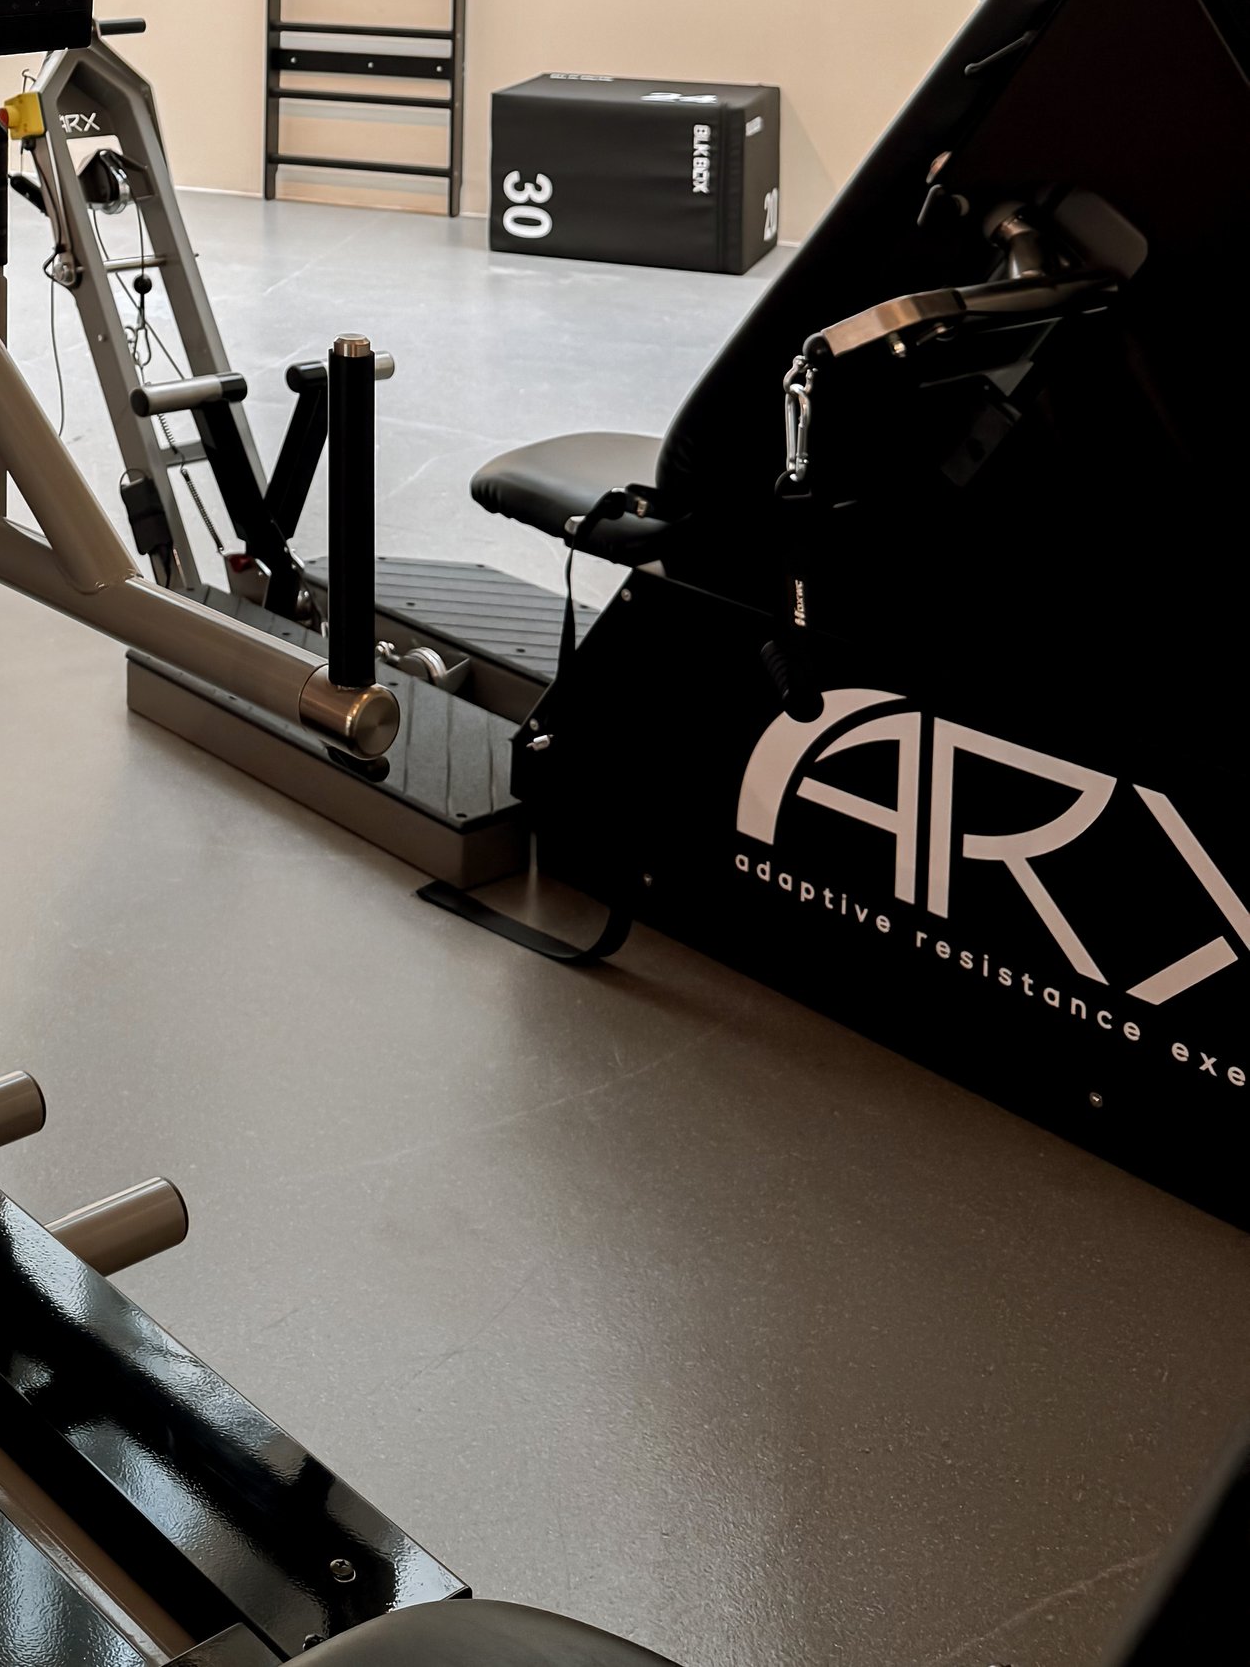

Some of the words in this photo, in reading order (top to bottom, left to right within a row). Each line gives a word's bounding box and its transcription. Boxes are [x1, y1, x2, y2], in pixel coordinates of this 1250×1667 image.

[502, 170, 553, 239] 30
[736, 688, 1250, 1006] ARX
[735, 854, 891, 933] adaptive
[915, 930, 1141, 1041] resistance
